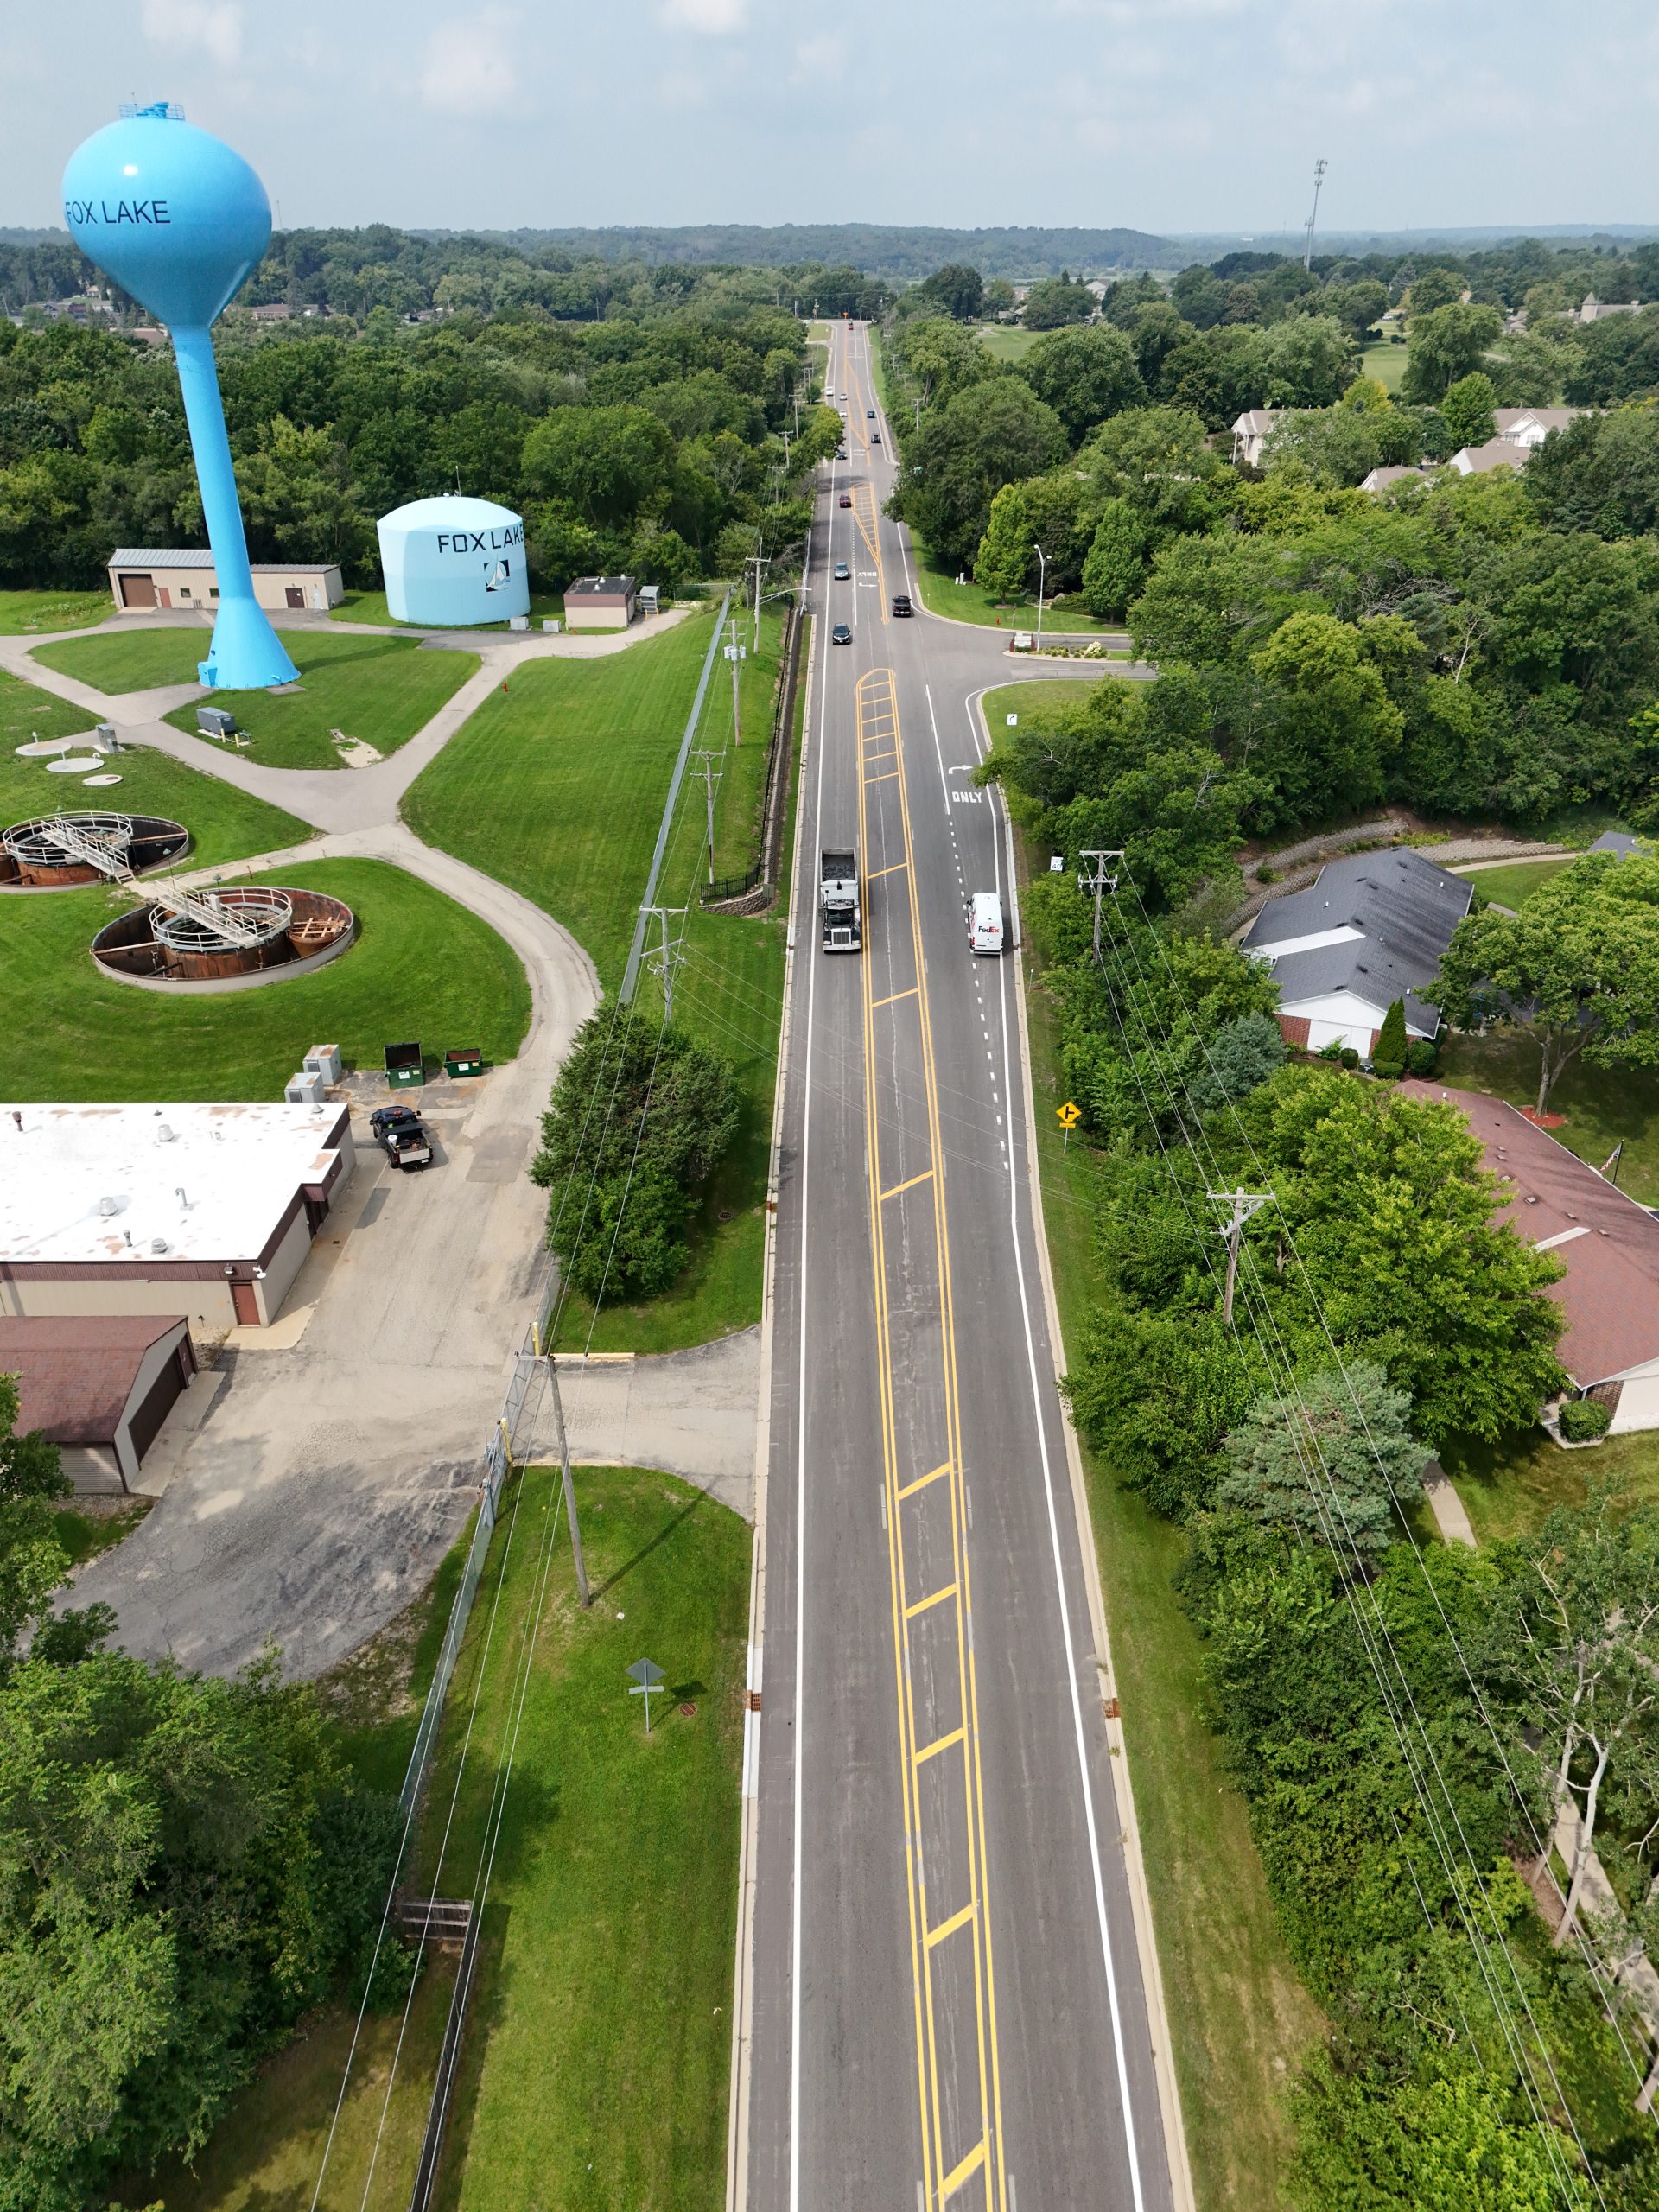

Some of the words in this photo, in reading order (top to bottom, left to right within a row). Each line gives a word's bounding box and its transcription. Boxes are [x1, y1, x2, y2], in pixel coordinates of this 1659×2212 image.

[65, 200, 98, 224] FOX
[101, 200, 171, 224] LAKE
[437, 531, 486, 553] FOX
[951, 791, 982, 804] ONLY
